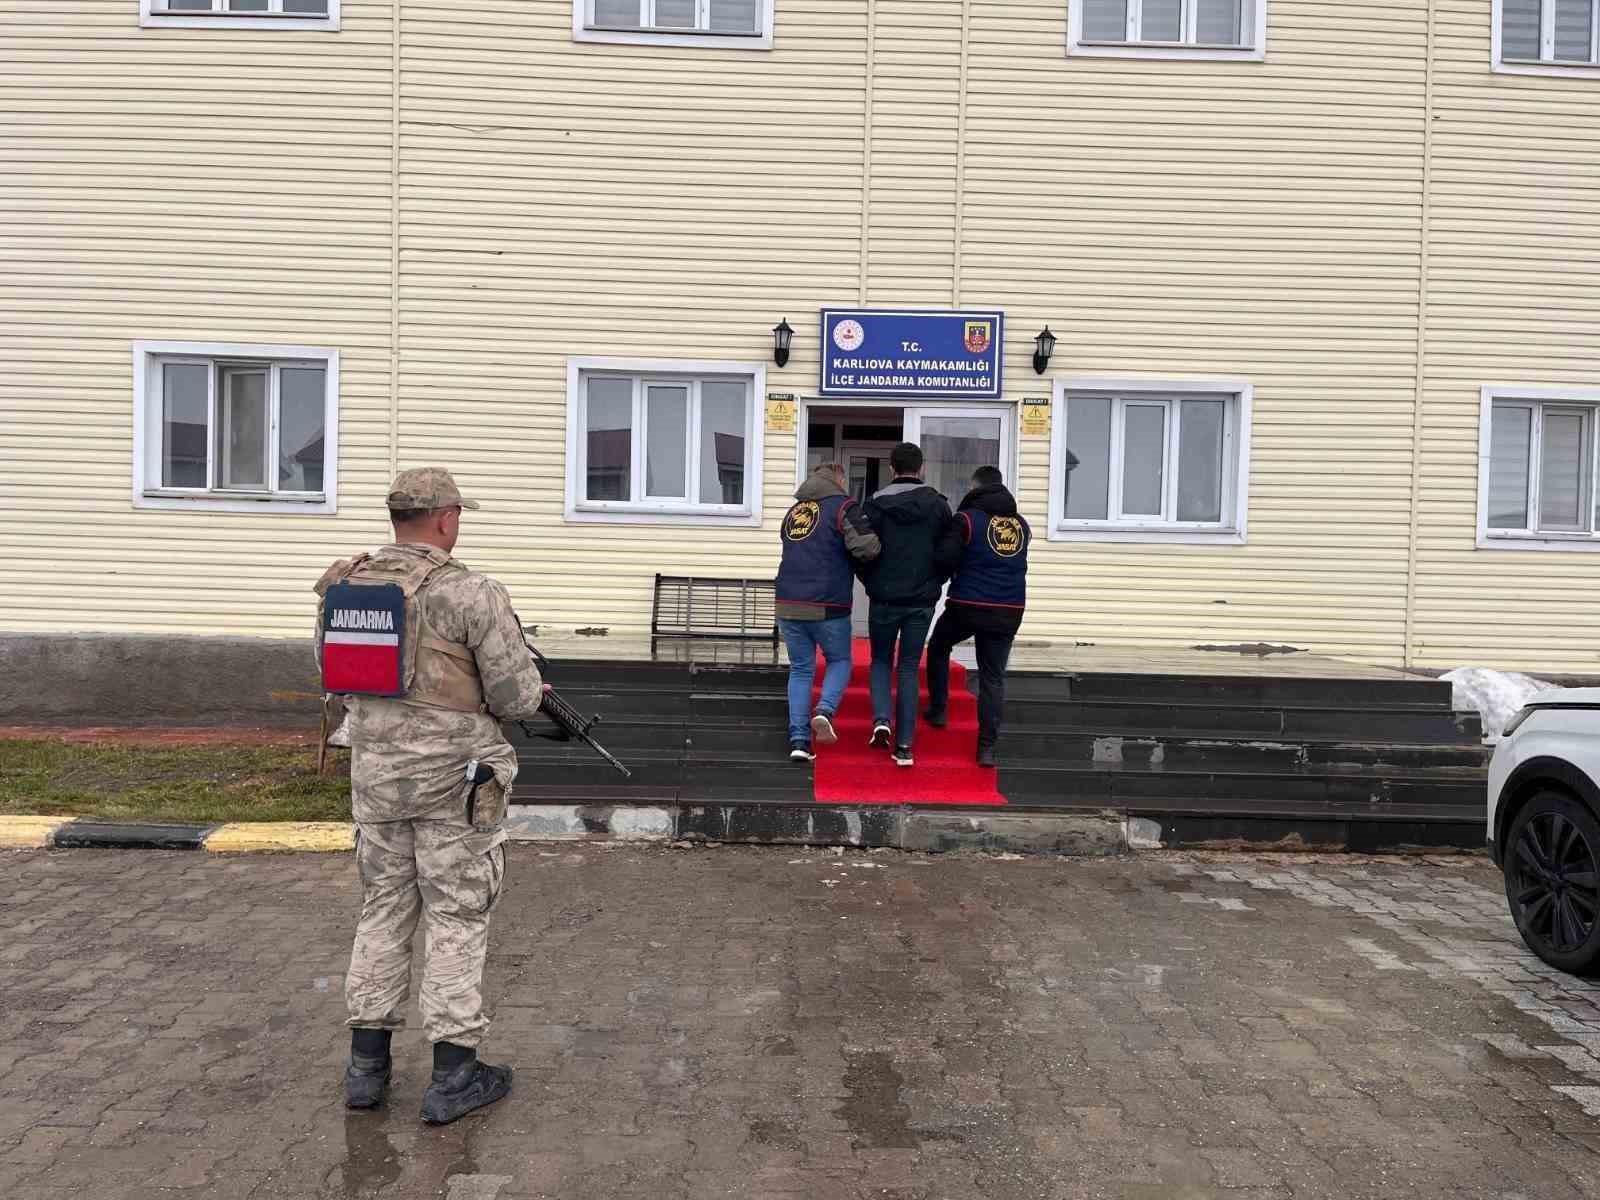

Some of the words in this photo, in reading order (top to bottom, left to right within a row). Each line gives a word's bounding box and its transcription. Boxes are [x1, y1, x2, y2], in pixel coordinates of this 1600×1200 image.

[901, 341, 922, 352] T.C.
[833, 358, 893, 369] KARLIOVA
[897, 359, 989, 371] KAYMAKAMLIĞI
[857, 375, 915, 387] JANDARMA
[917, 376, 990, 388] KOMUTANLIĞI
[330, 608, 394, 631] JANDARMA
